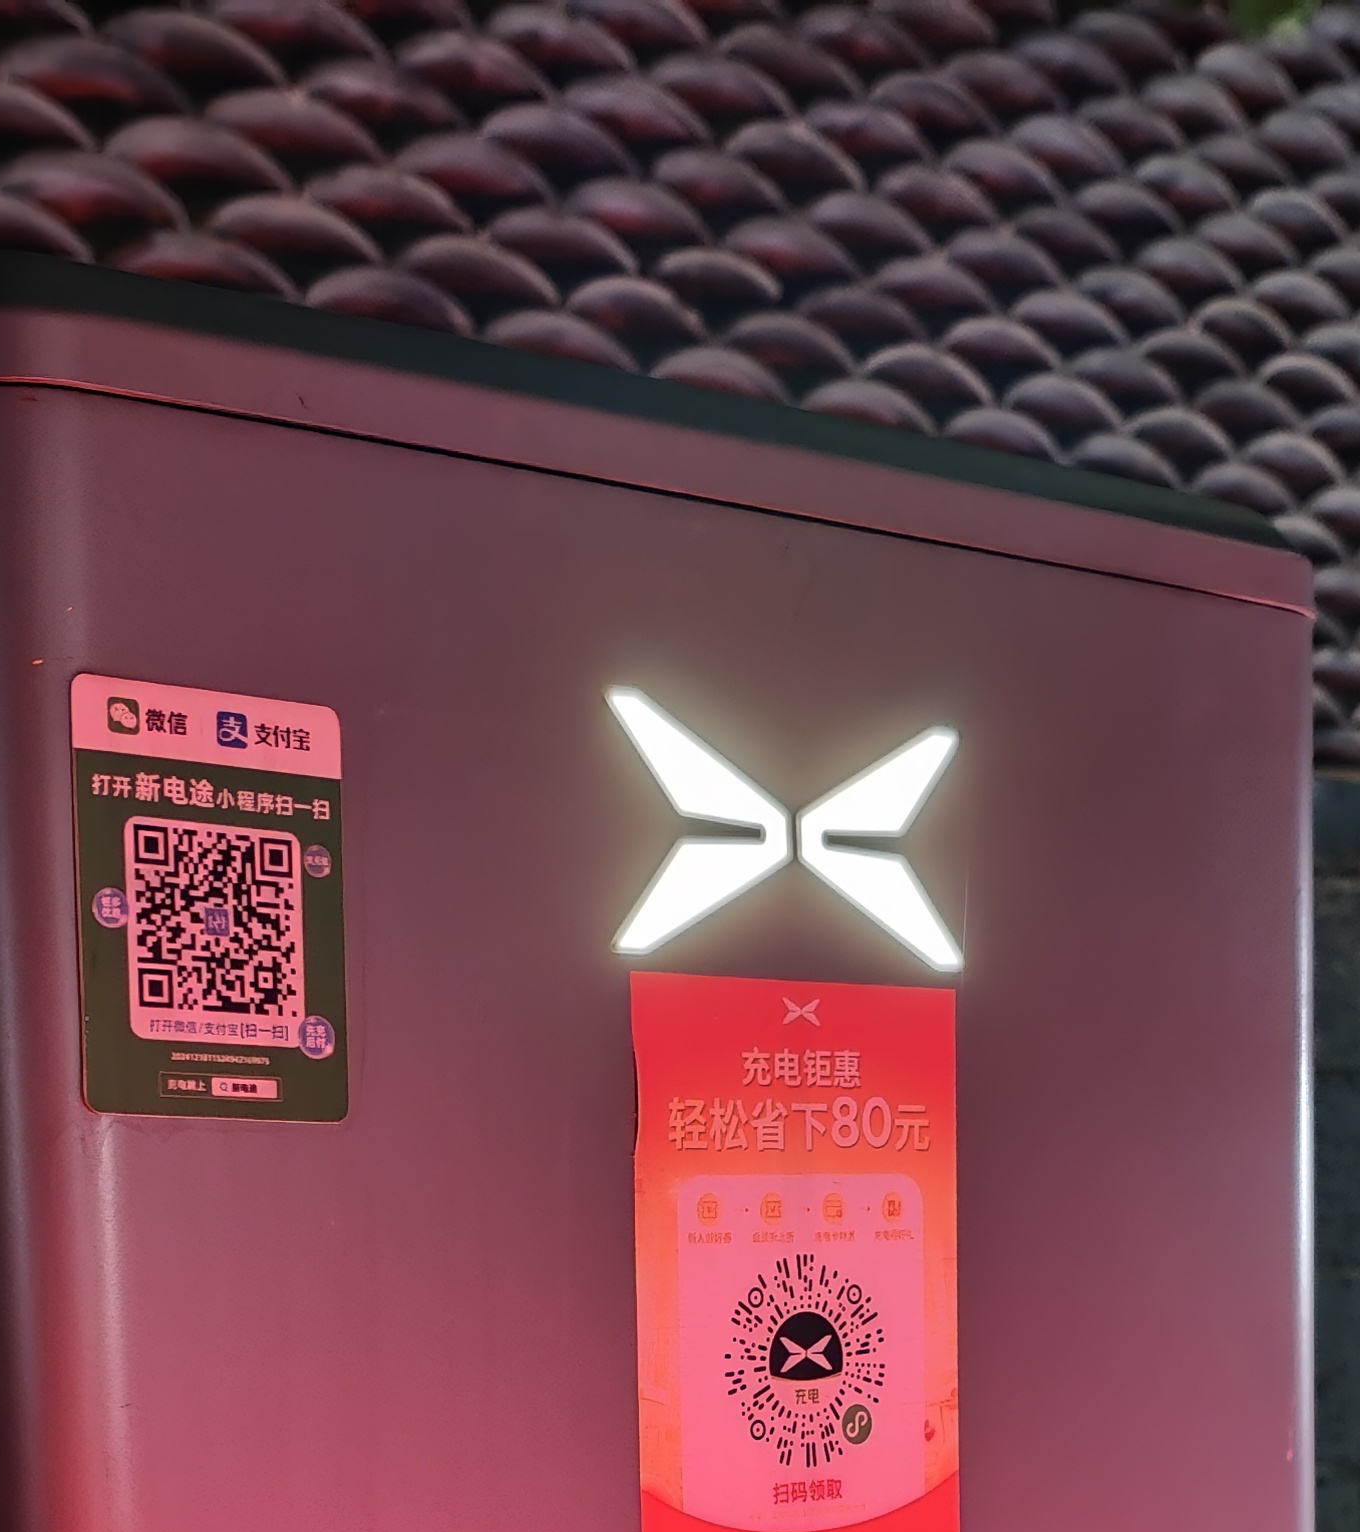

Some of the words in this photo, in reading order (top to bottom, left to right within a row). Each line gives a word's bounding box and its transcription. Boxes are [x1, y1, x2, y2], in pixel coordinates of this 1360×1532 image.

[146, 708, 188, 736] 微信
[254, 725, 311, 752] 支付宝
[92, 772, 331, 820] 打开新电途小程序扫一扫
[742, 1049, 862, 1086] 充电钜惠
[667, 1095, 931, 1152] 轻松省下80元
[794, 1388, 820, 1404] 充电
[772, 1478, 843, 1505] 扫码领取
